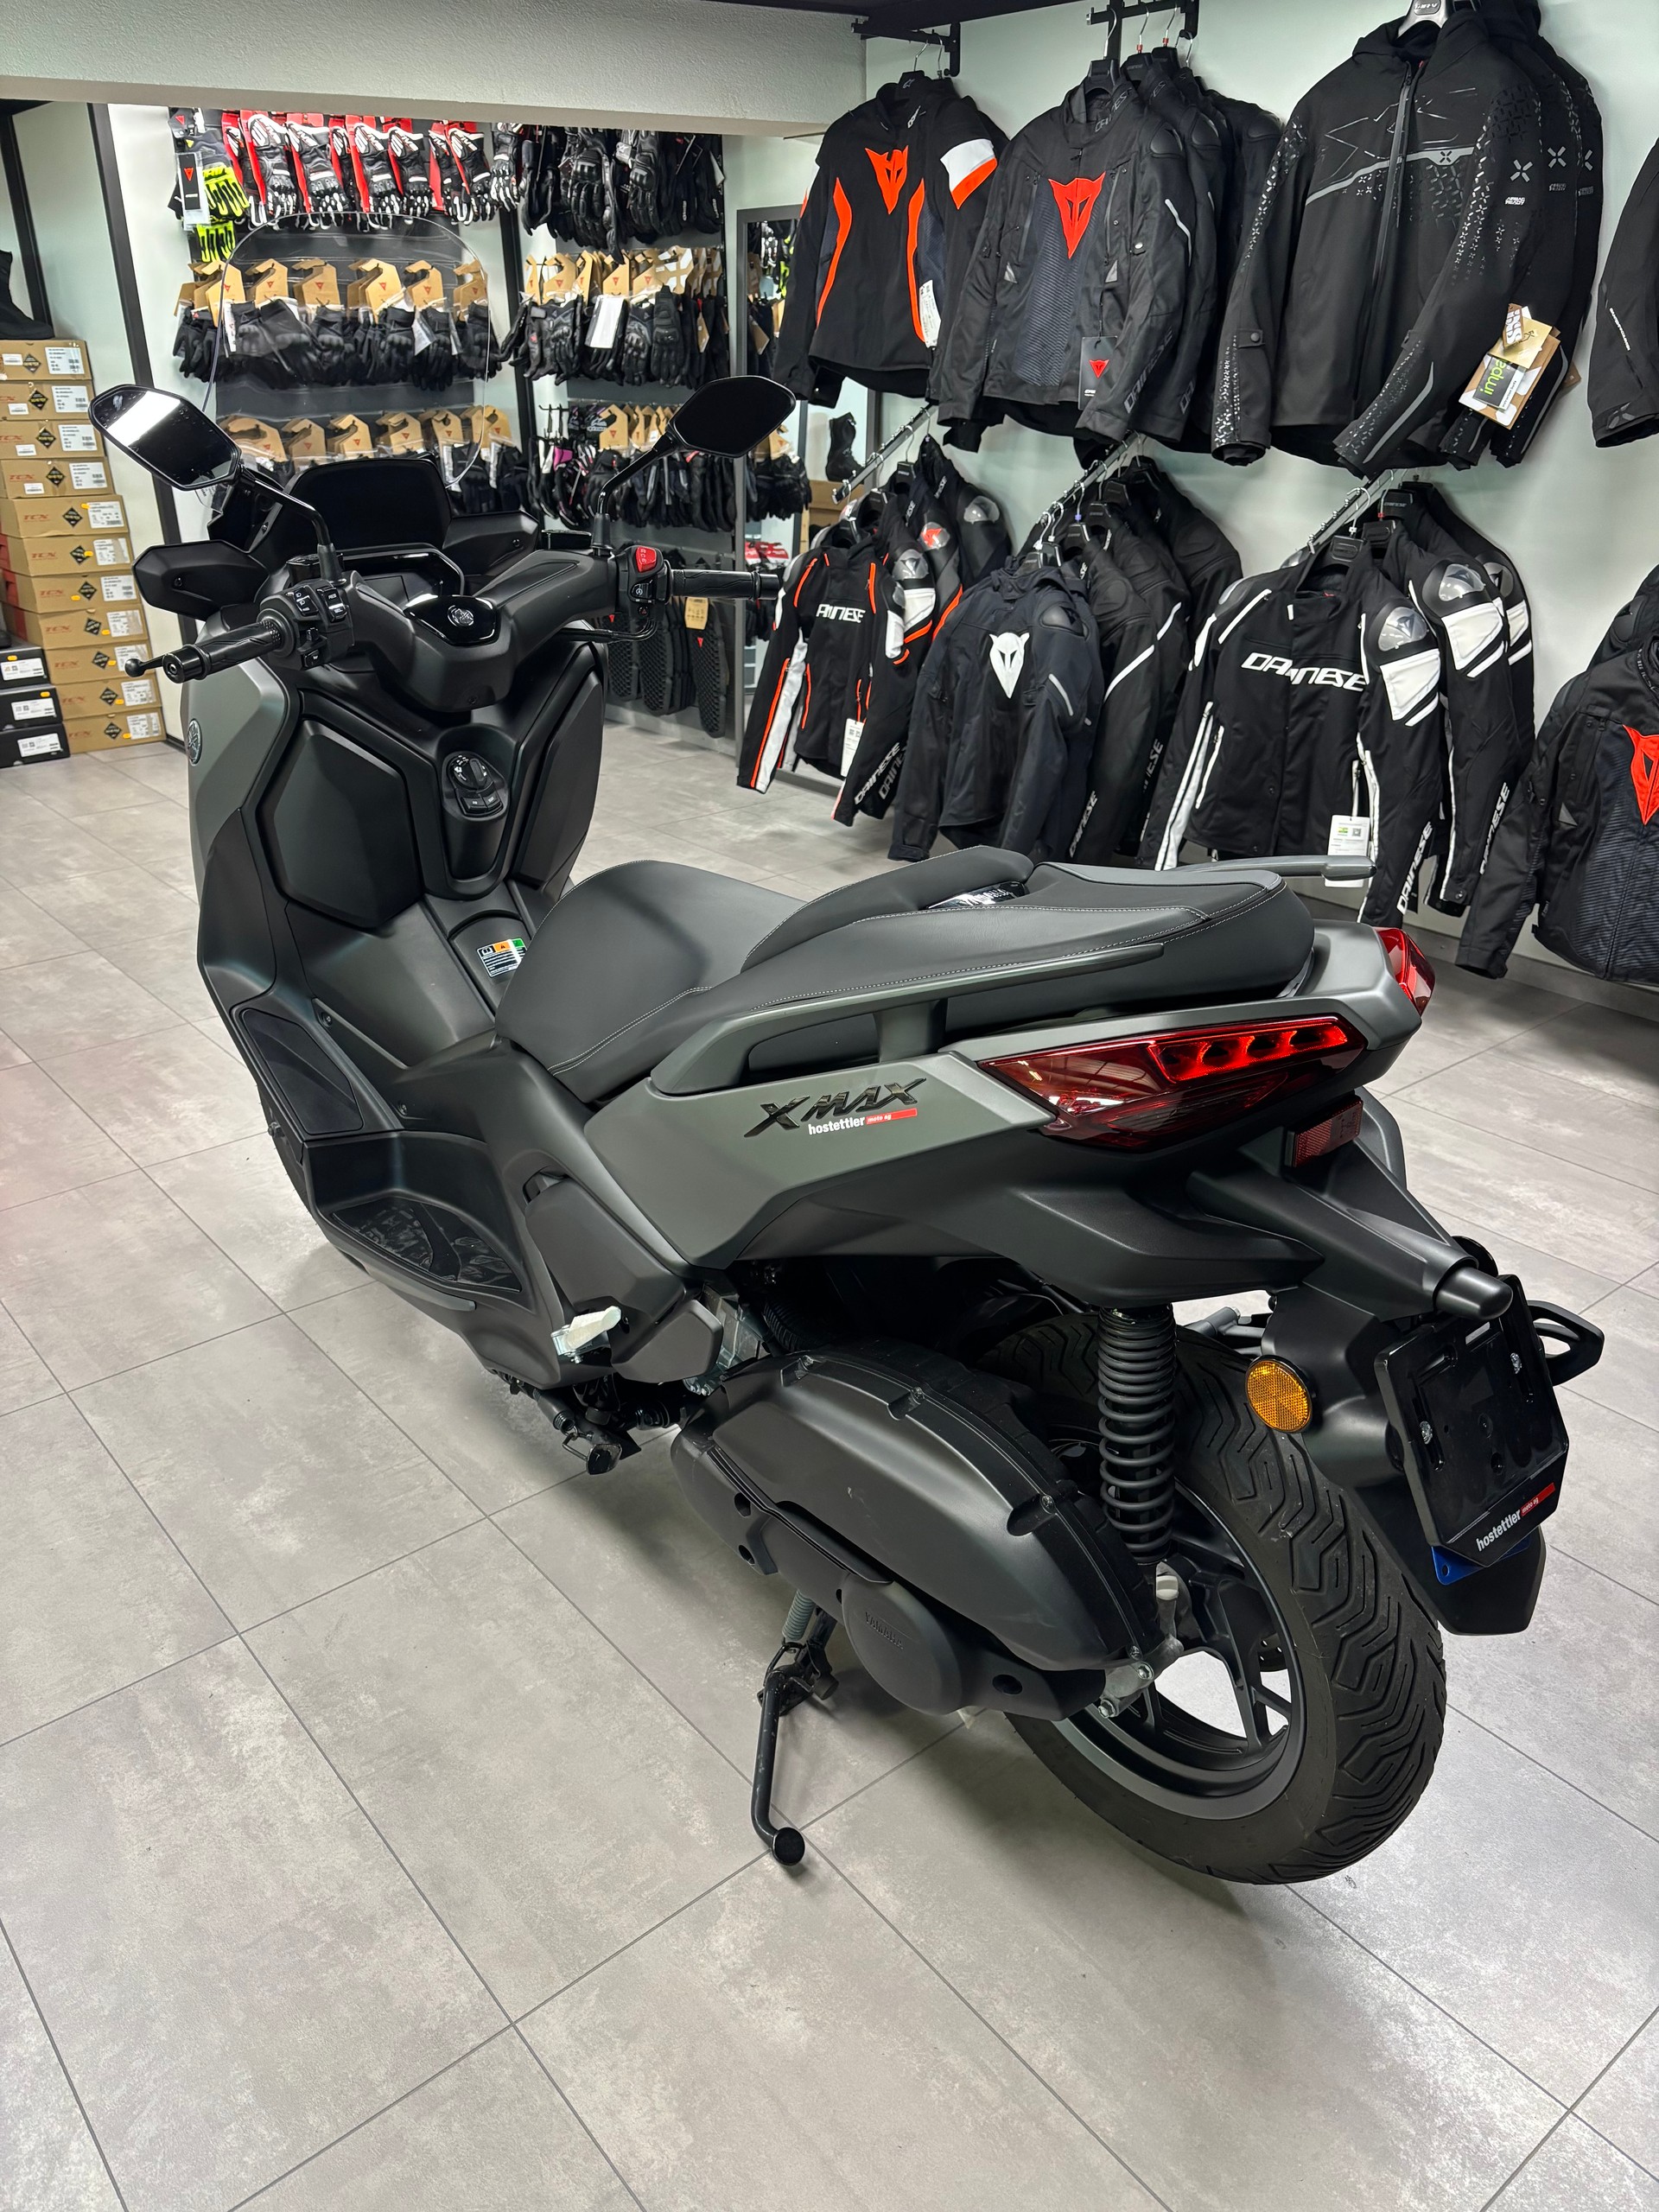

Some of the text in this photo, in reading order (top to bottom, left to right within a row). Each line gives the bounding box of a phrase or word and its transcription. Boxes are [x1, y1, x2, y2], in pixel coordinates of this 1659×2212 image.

[1479, 359, 1508, 397] impa
[1241, 652, 1367, 692] DAINESE
[1396, 821, 1433, 915] DAINESE
[808, 1116, 866, 1135] hostettler
[1475, 1509, 1521, 1552] hostettler
